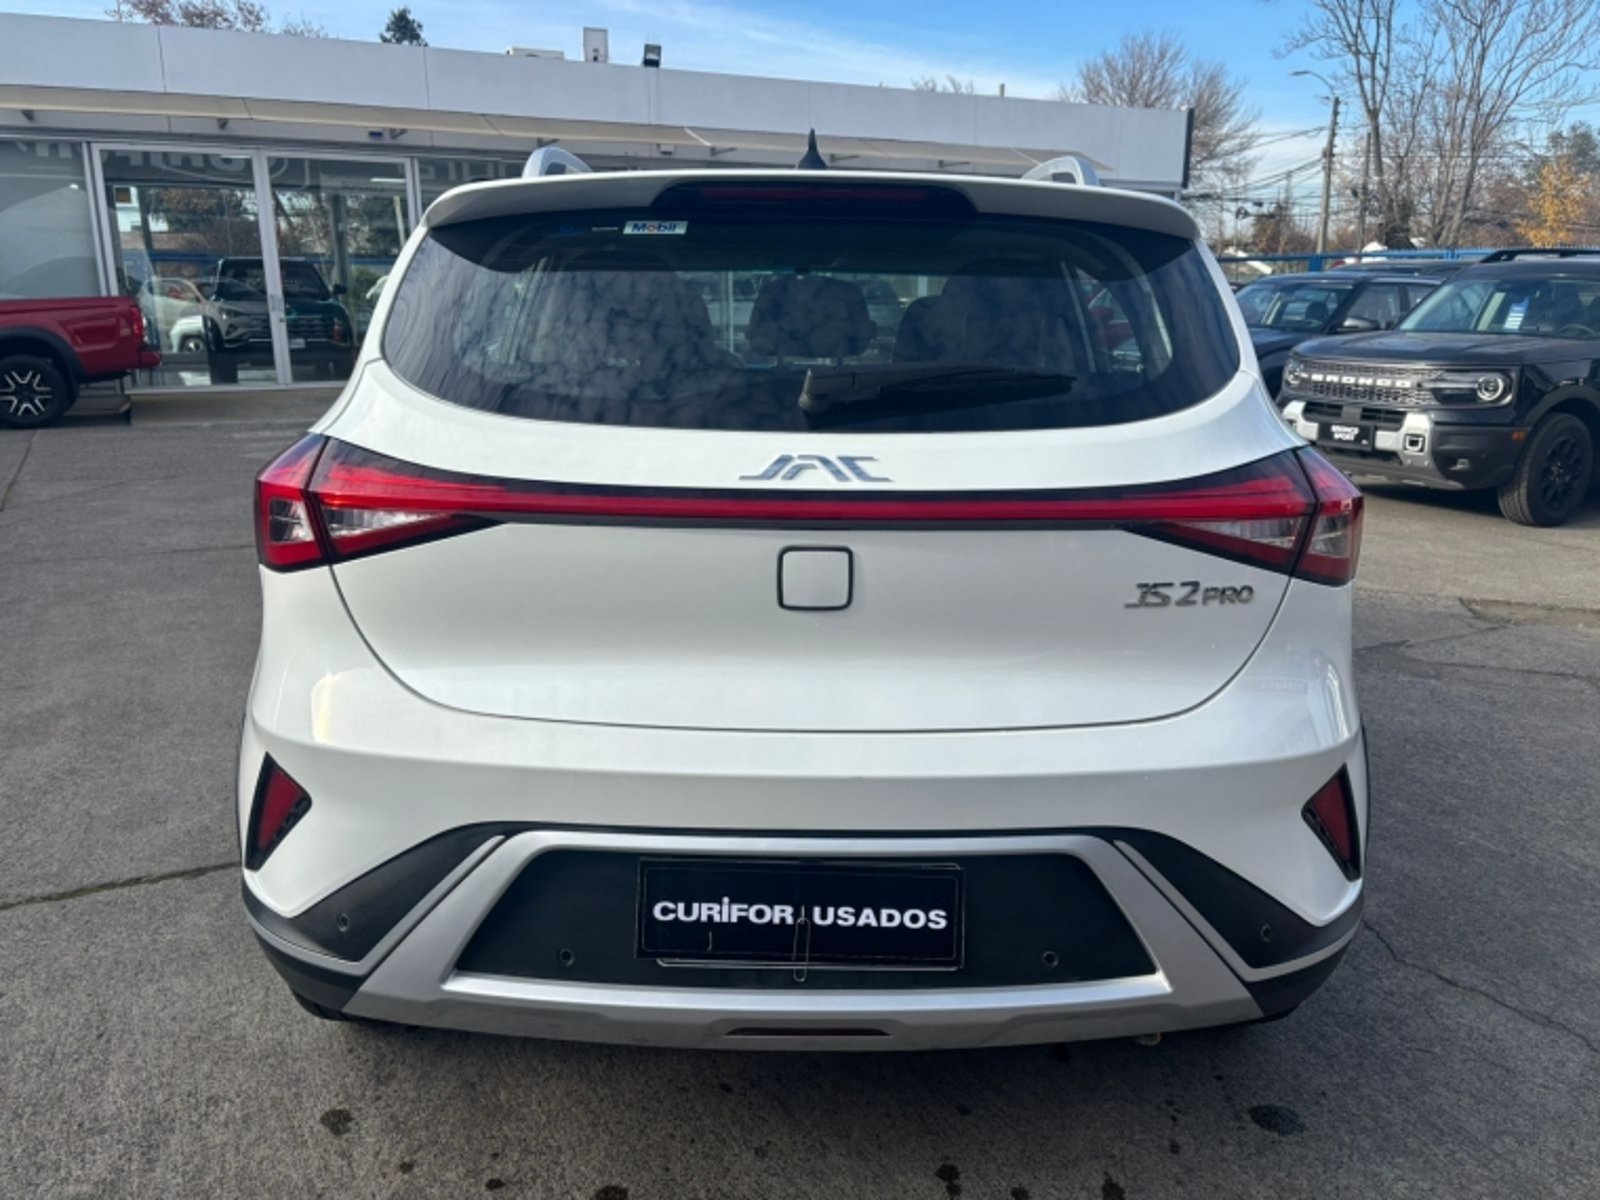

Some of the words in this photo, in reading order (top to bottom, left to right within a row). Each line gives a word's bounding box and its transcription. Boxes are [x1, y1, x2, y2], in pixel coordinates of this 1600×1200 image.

[632, 221, 677, 233] Mobil
[1311, 374, 1412, 388] BRONCO
[738, 454, 894, 482] JAC
[812, 906, 948, 930] USADOS
